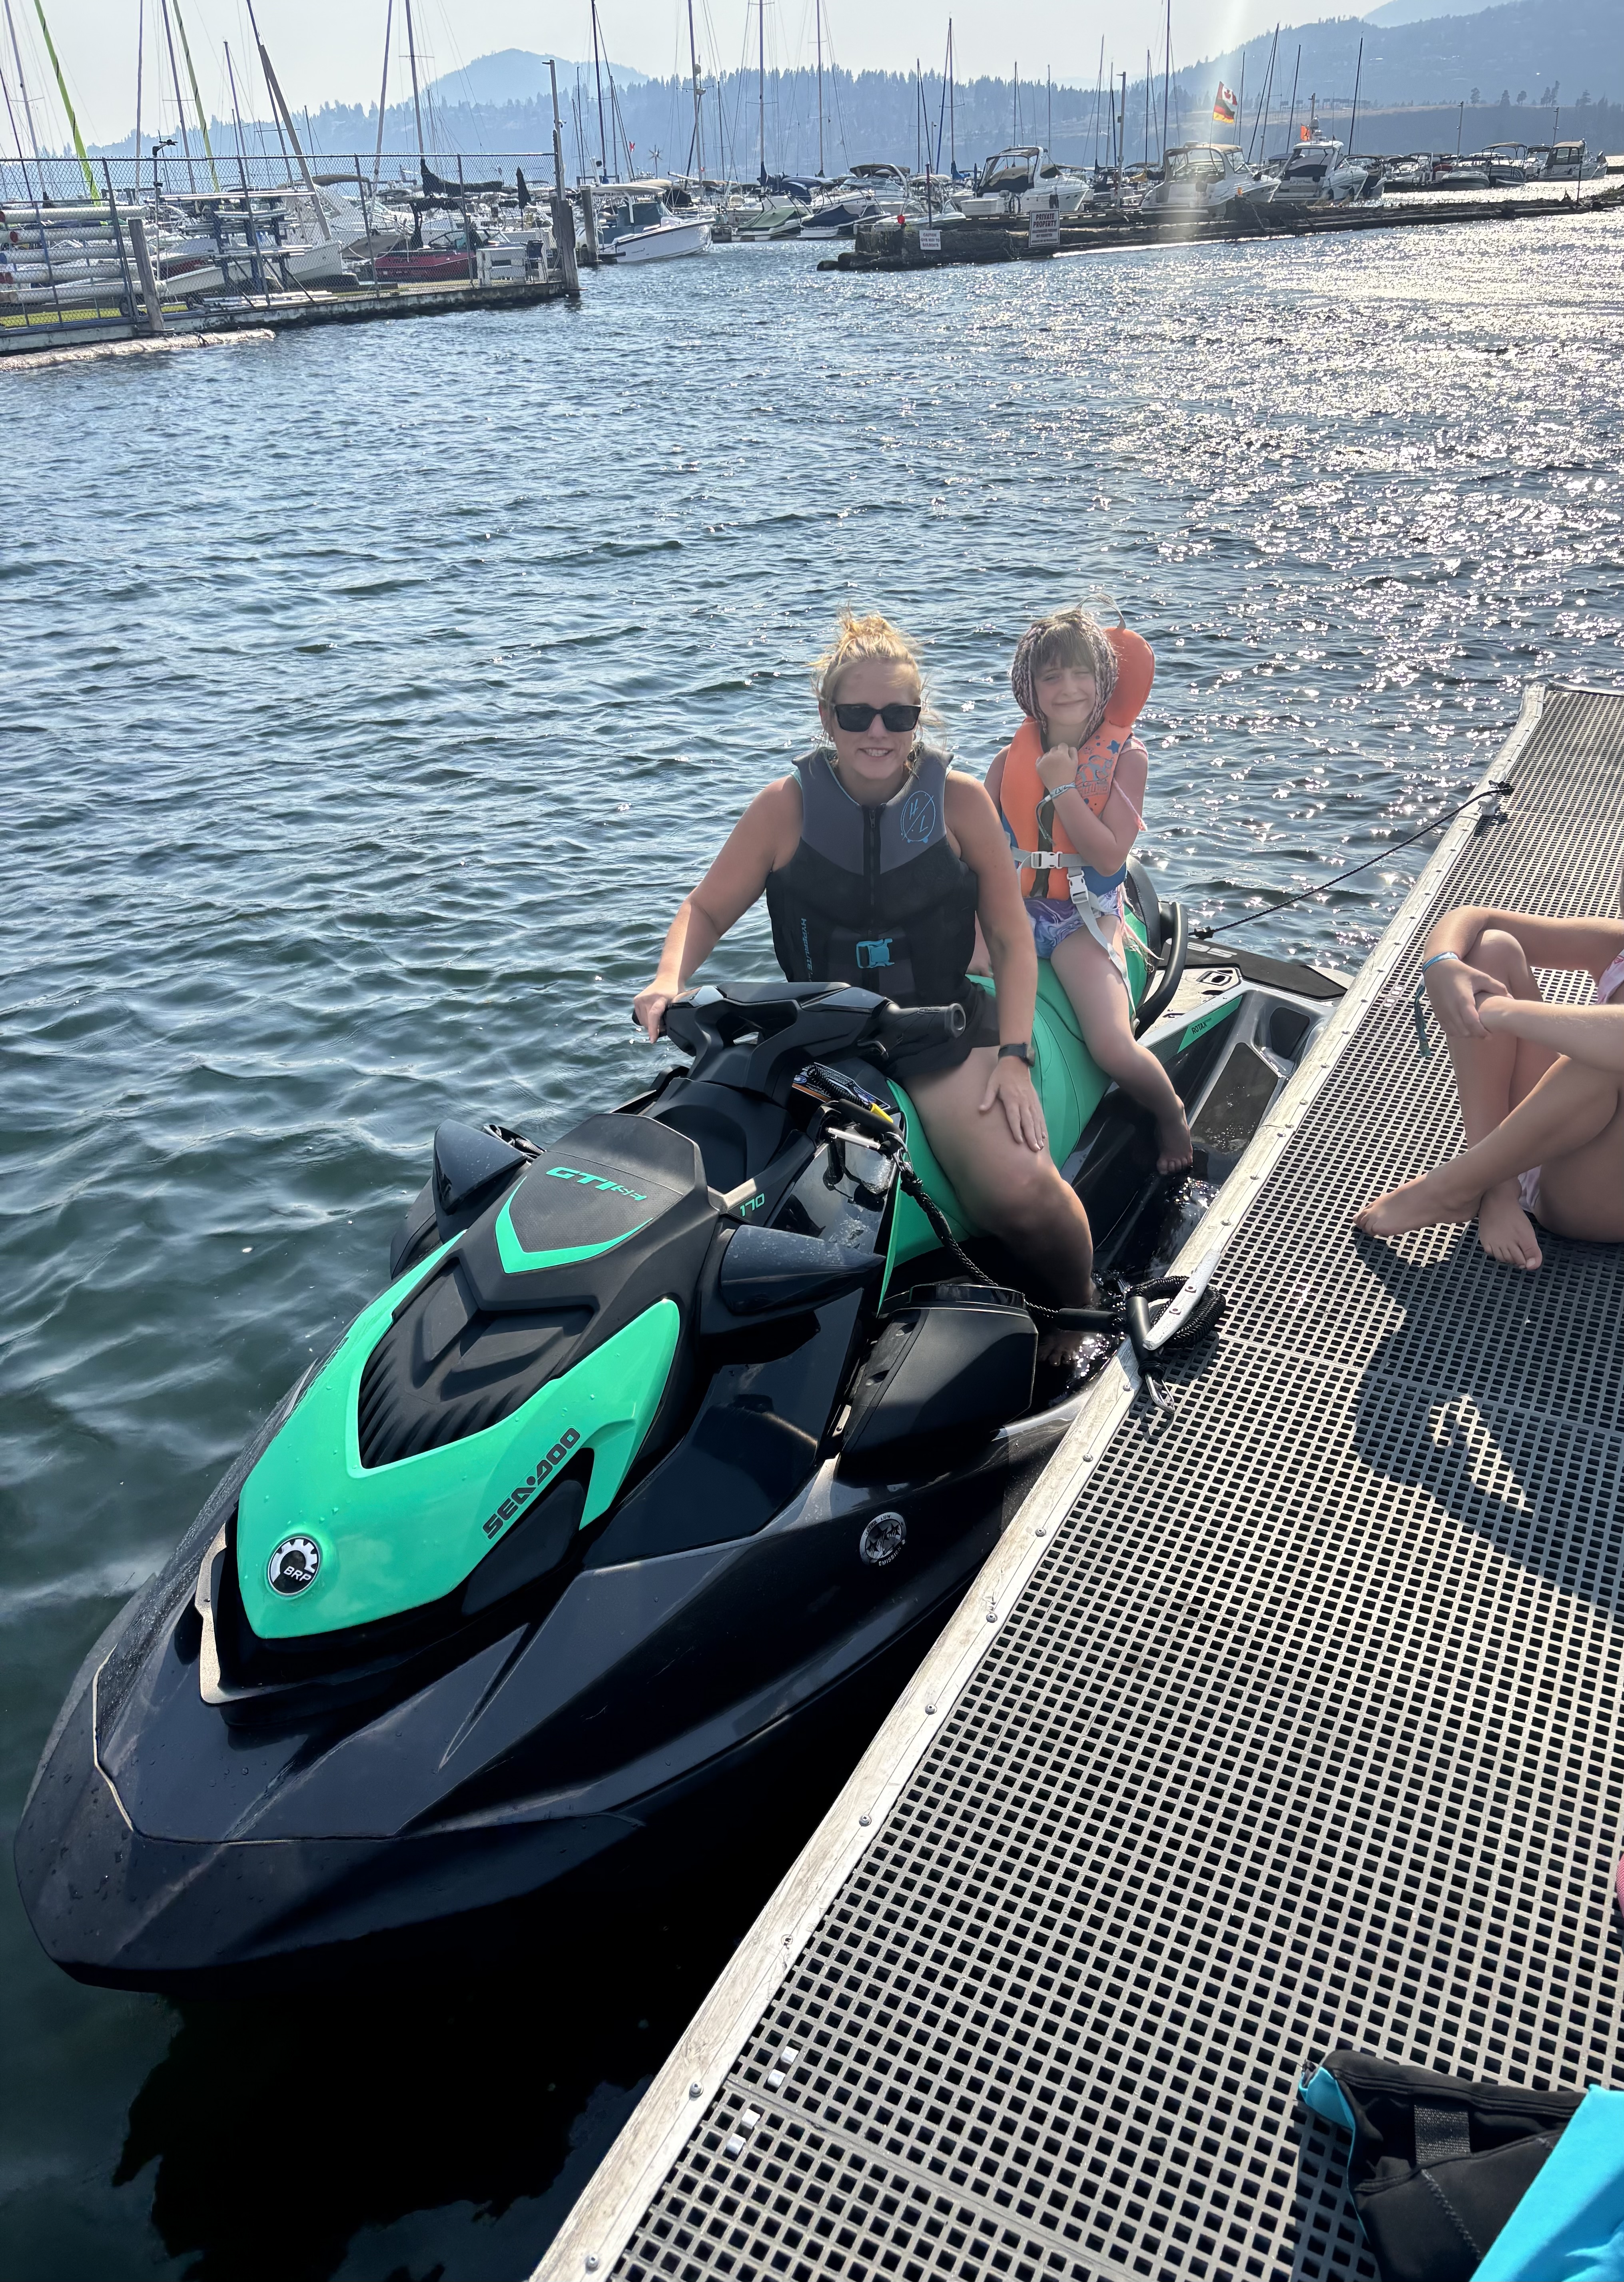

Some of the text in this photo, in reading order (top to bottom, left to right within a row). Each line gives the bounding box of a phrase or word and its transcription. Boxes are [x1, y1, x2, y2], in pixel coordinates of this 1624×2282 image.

[801, 918, 812, 970] HYPERLITE
[1191, 1022, 1207, 1034] ROTAX
[740, 1193, 765, 1216] 170
[878, 1546, 902, 1566] EMISSION
[283, 1565, 315, 1581] BRP
